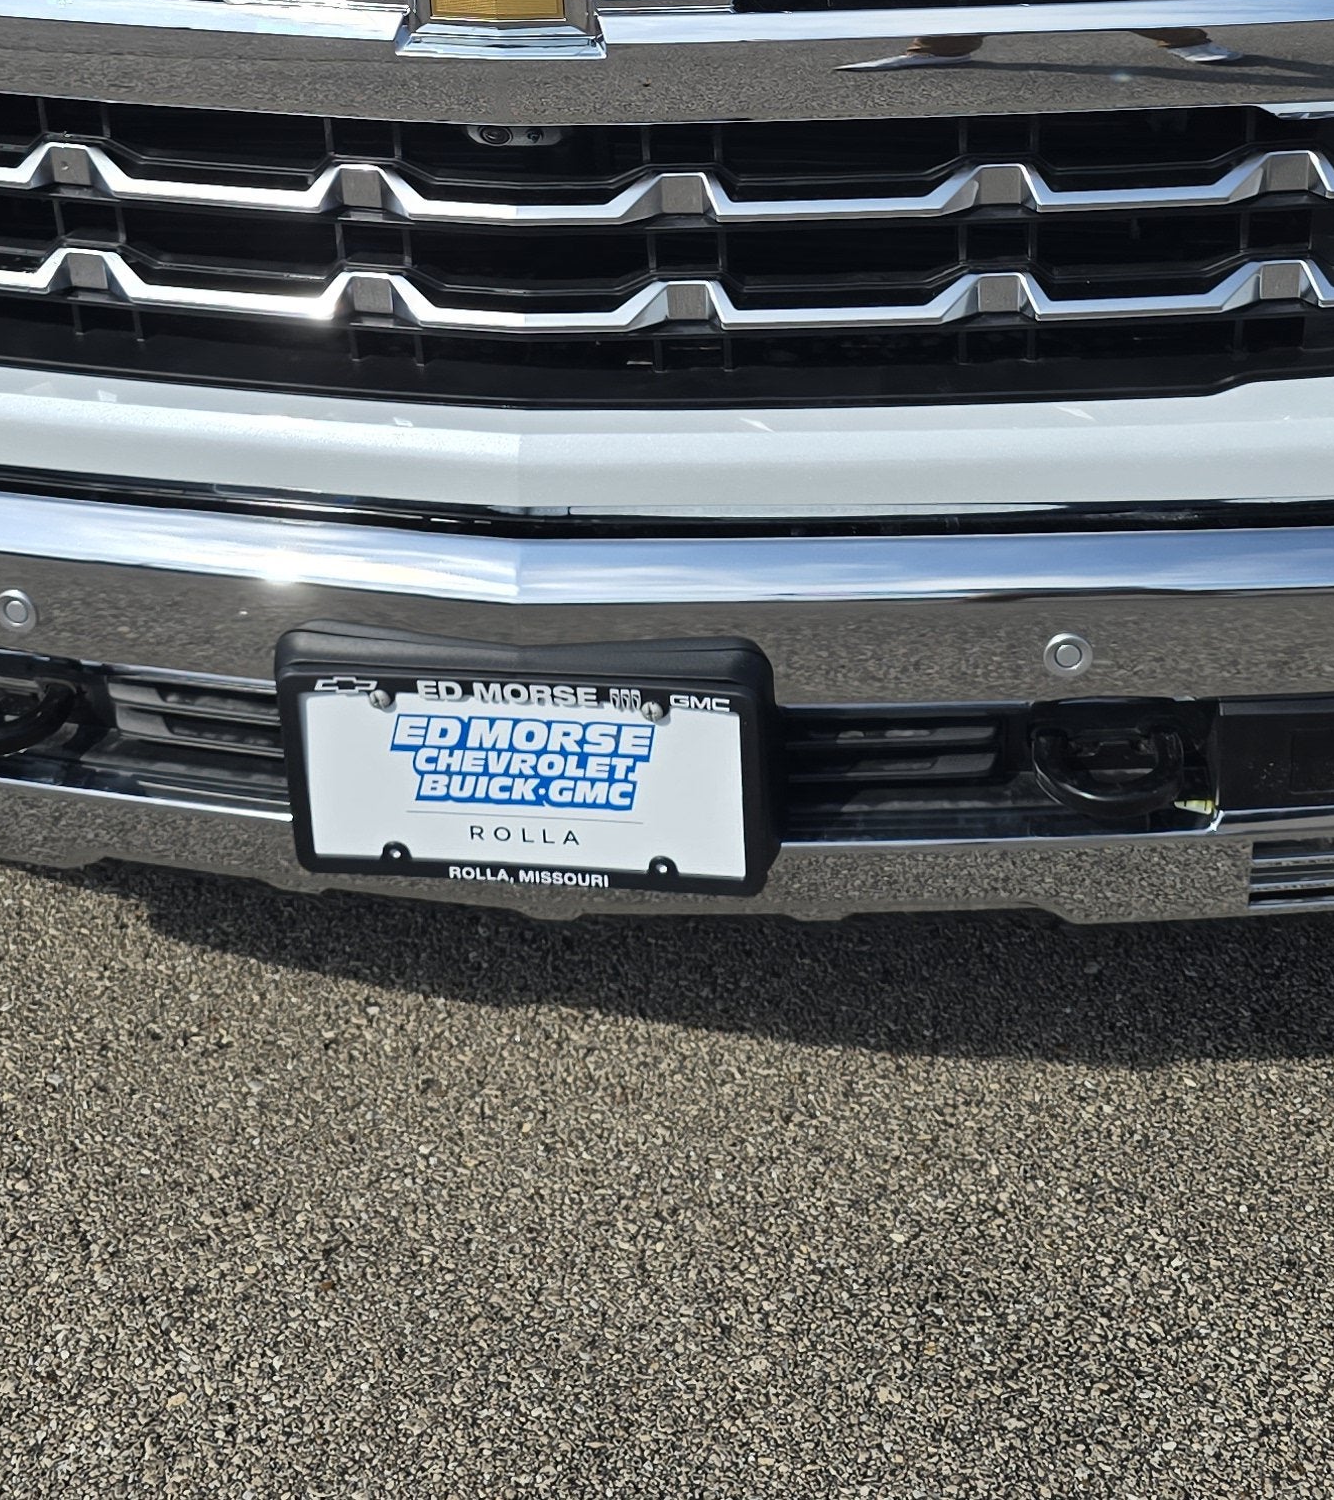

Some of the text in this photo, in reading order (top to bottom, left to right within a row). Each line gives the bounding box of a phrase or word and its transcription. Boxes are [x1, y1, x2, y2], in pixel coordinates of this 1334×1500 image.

[416, 680, 598, 707] ED MORSE
[669, 694, 731, 713] GMC
[392, 716, 654, 756] ED MORSE
[469, 825, 580, 846] ROLLA
[448, 866, 609, 888] ROLLA, MISSOURI
